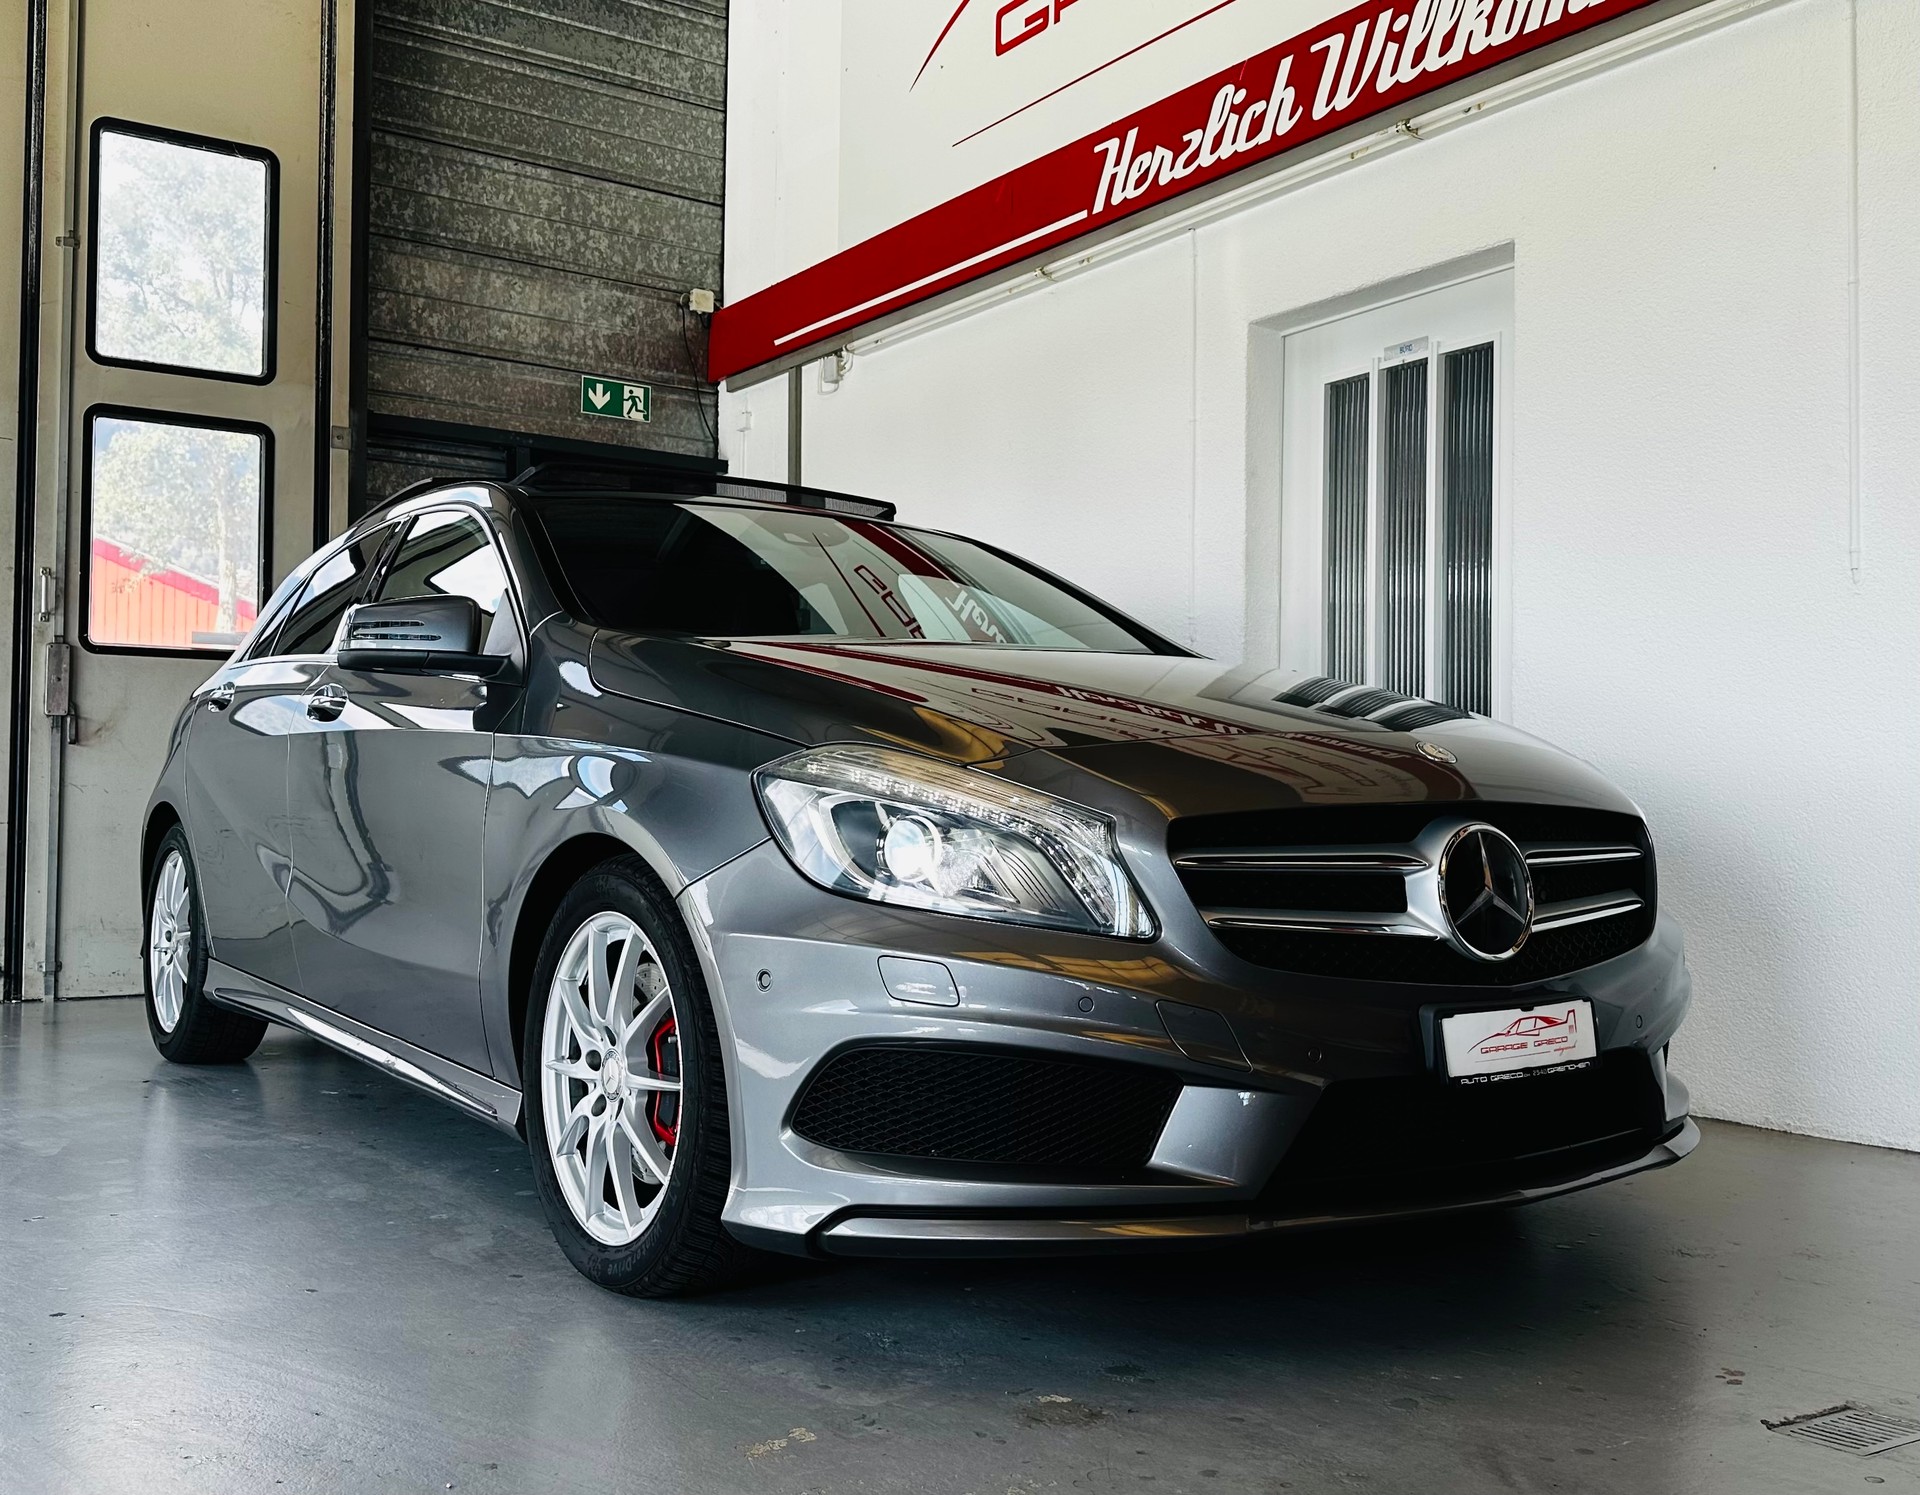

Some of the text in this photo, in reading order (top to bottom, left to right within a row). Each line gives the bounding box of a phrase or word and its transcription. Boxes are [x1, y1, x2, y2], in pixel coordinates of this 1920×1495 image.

[1092, 0, 1606, 215] Herzlich Willko
[1480, 1036, 1568, 1054] GARAGE GRECO
[1460, 1076, 1488, 1085] AUTO
[1490, 1072, 1523, 1081] GRECO
